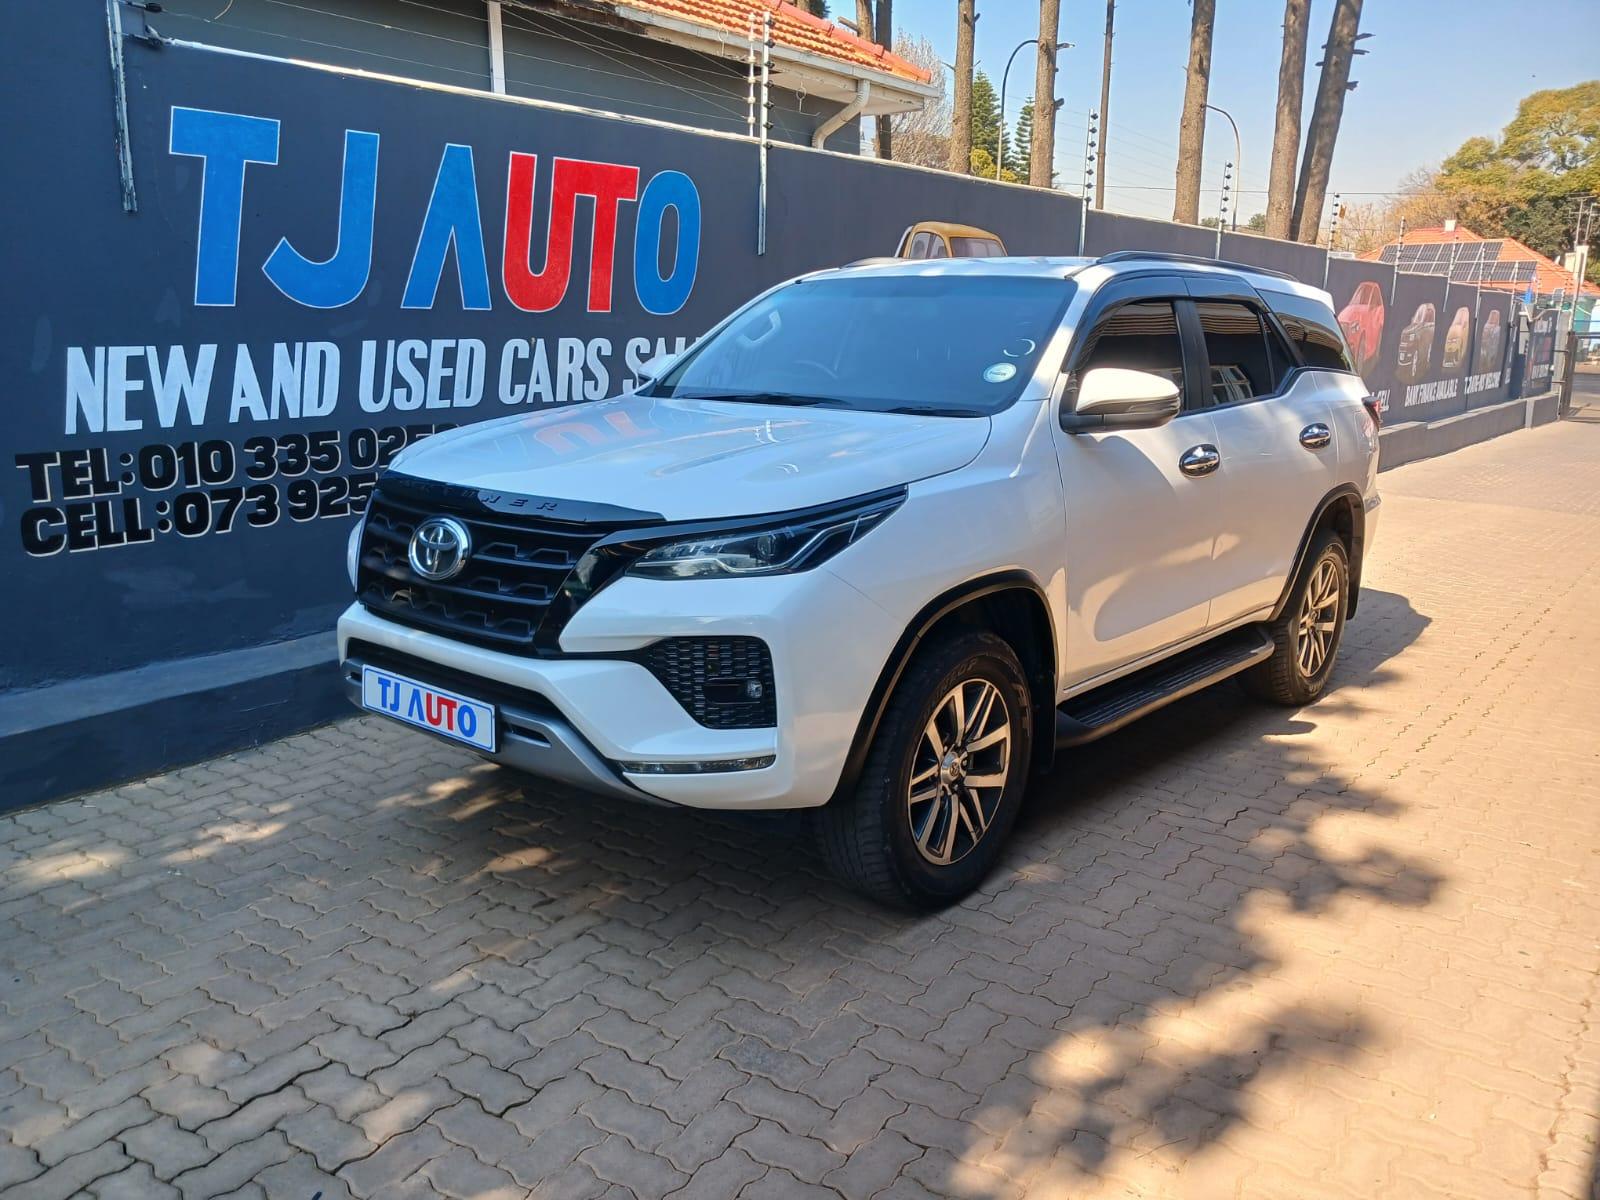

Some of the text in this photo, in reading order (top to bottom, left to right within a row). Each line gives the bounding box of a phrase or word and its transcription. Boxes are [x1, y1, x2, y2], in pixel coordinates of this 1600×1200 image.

[169, 105, 701, 315] TJ AUTO
[65, 344, 217, 434] NEW
[229, 340, 341, 423] AND
[359, 339, 486, 413] USED
[498, 337, 612, 405] CARS
[244, 434, 342, 480] 335
[350, 424, 461, 471] 02
[286, 472, 378, 522] 925
[378, 677, 476, 738] TJ AUTO
